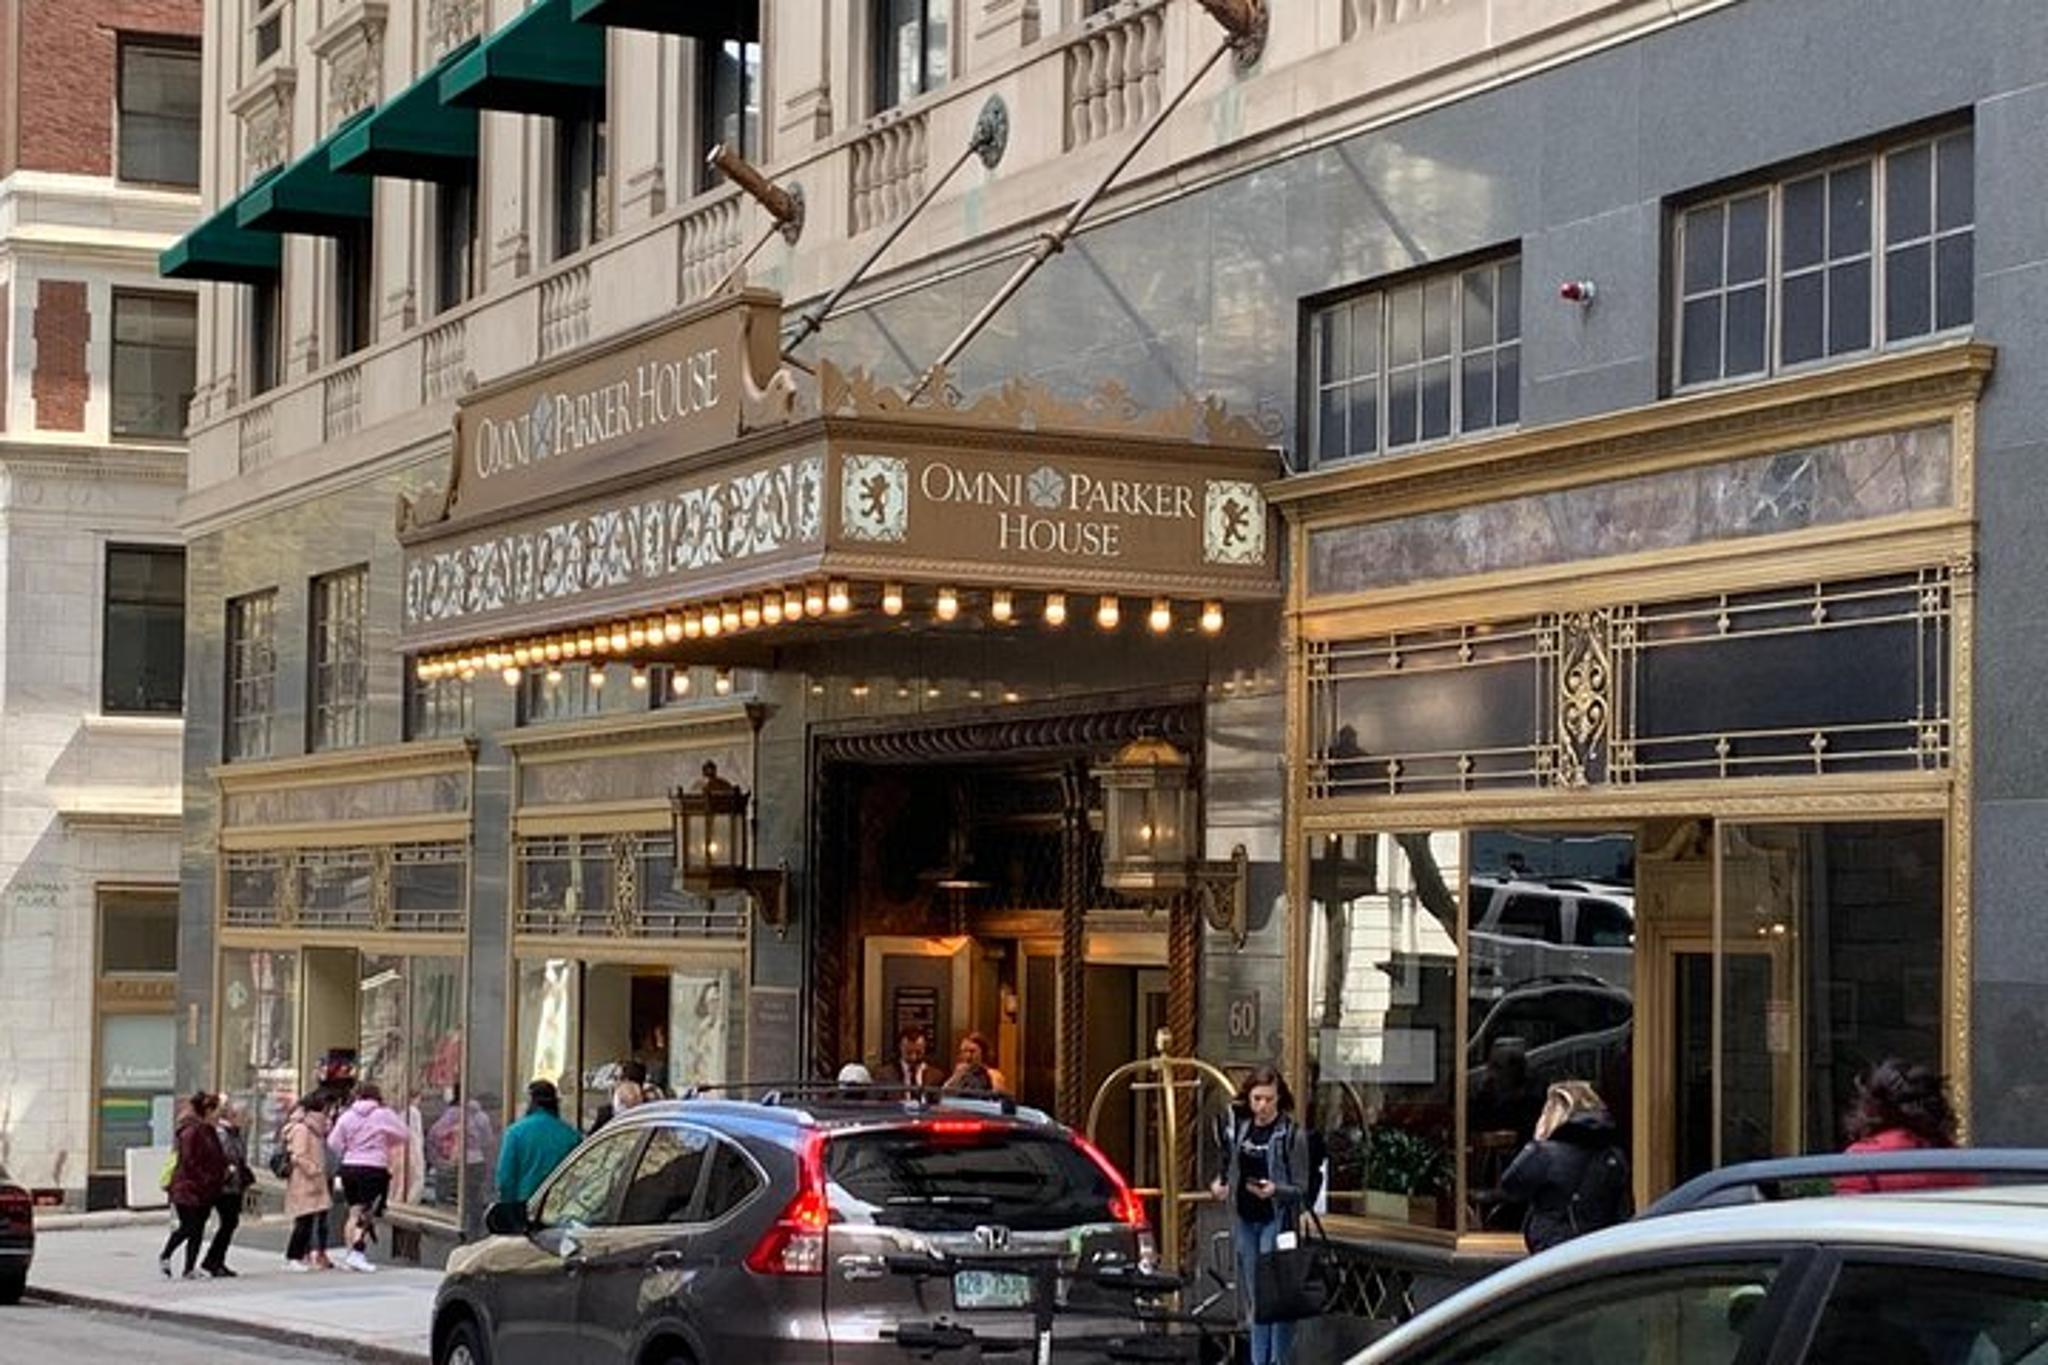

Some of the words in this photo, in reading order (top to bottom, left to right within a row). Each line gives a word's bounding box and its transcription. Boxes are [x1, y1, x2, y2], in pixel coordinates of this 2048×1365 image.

[476, 414, 530, 478] OMNI
[553, 379, 632, 456] PARKER
[637, 348, 720, 429] HOUSE
[920, 462, 1023, 507] OMNI
[1069, 474, 1197, 519] PARKER
[999, 511, 1121, 556] HOUSE
[1231, 1000, 1255, 1036] 60
